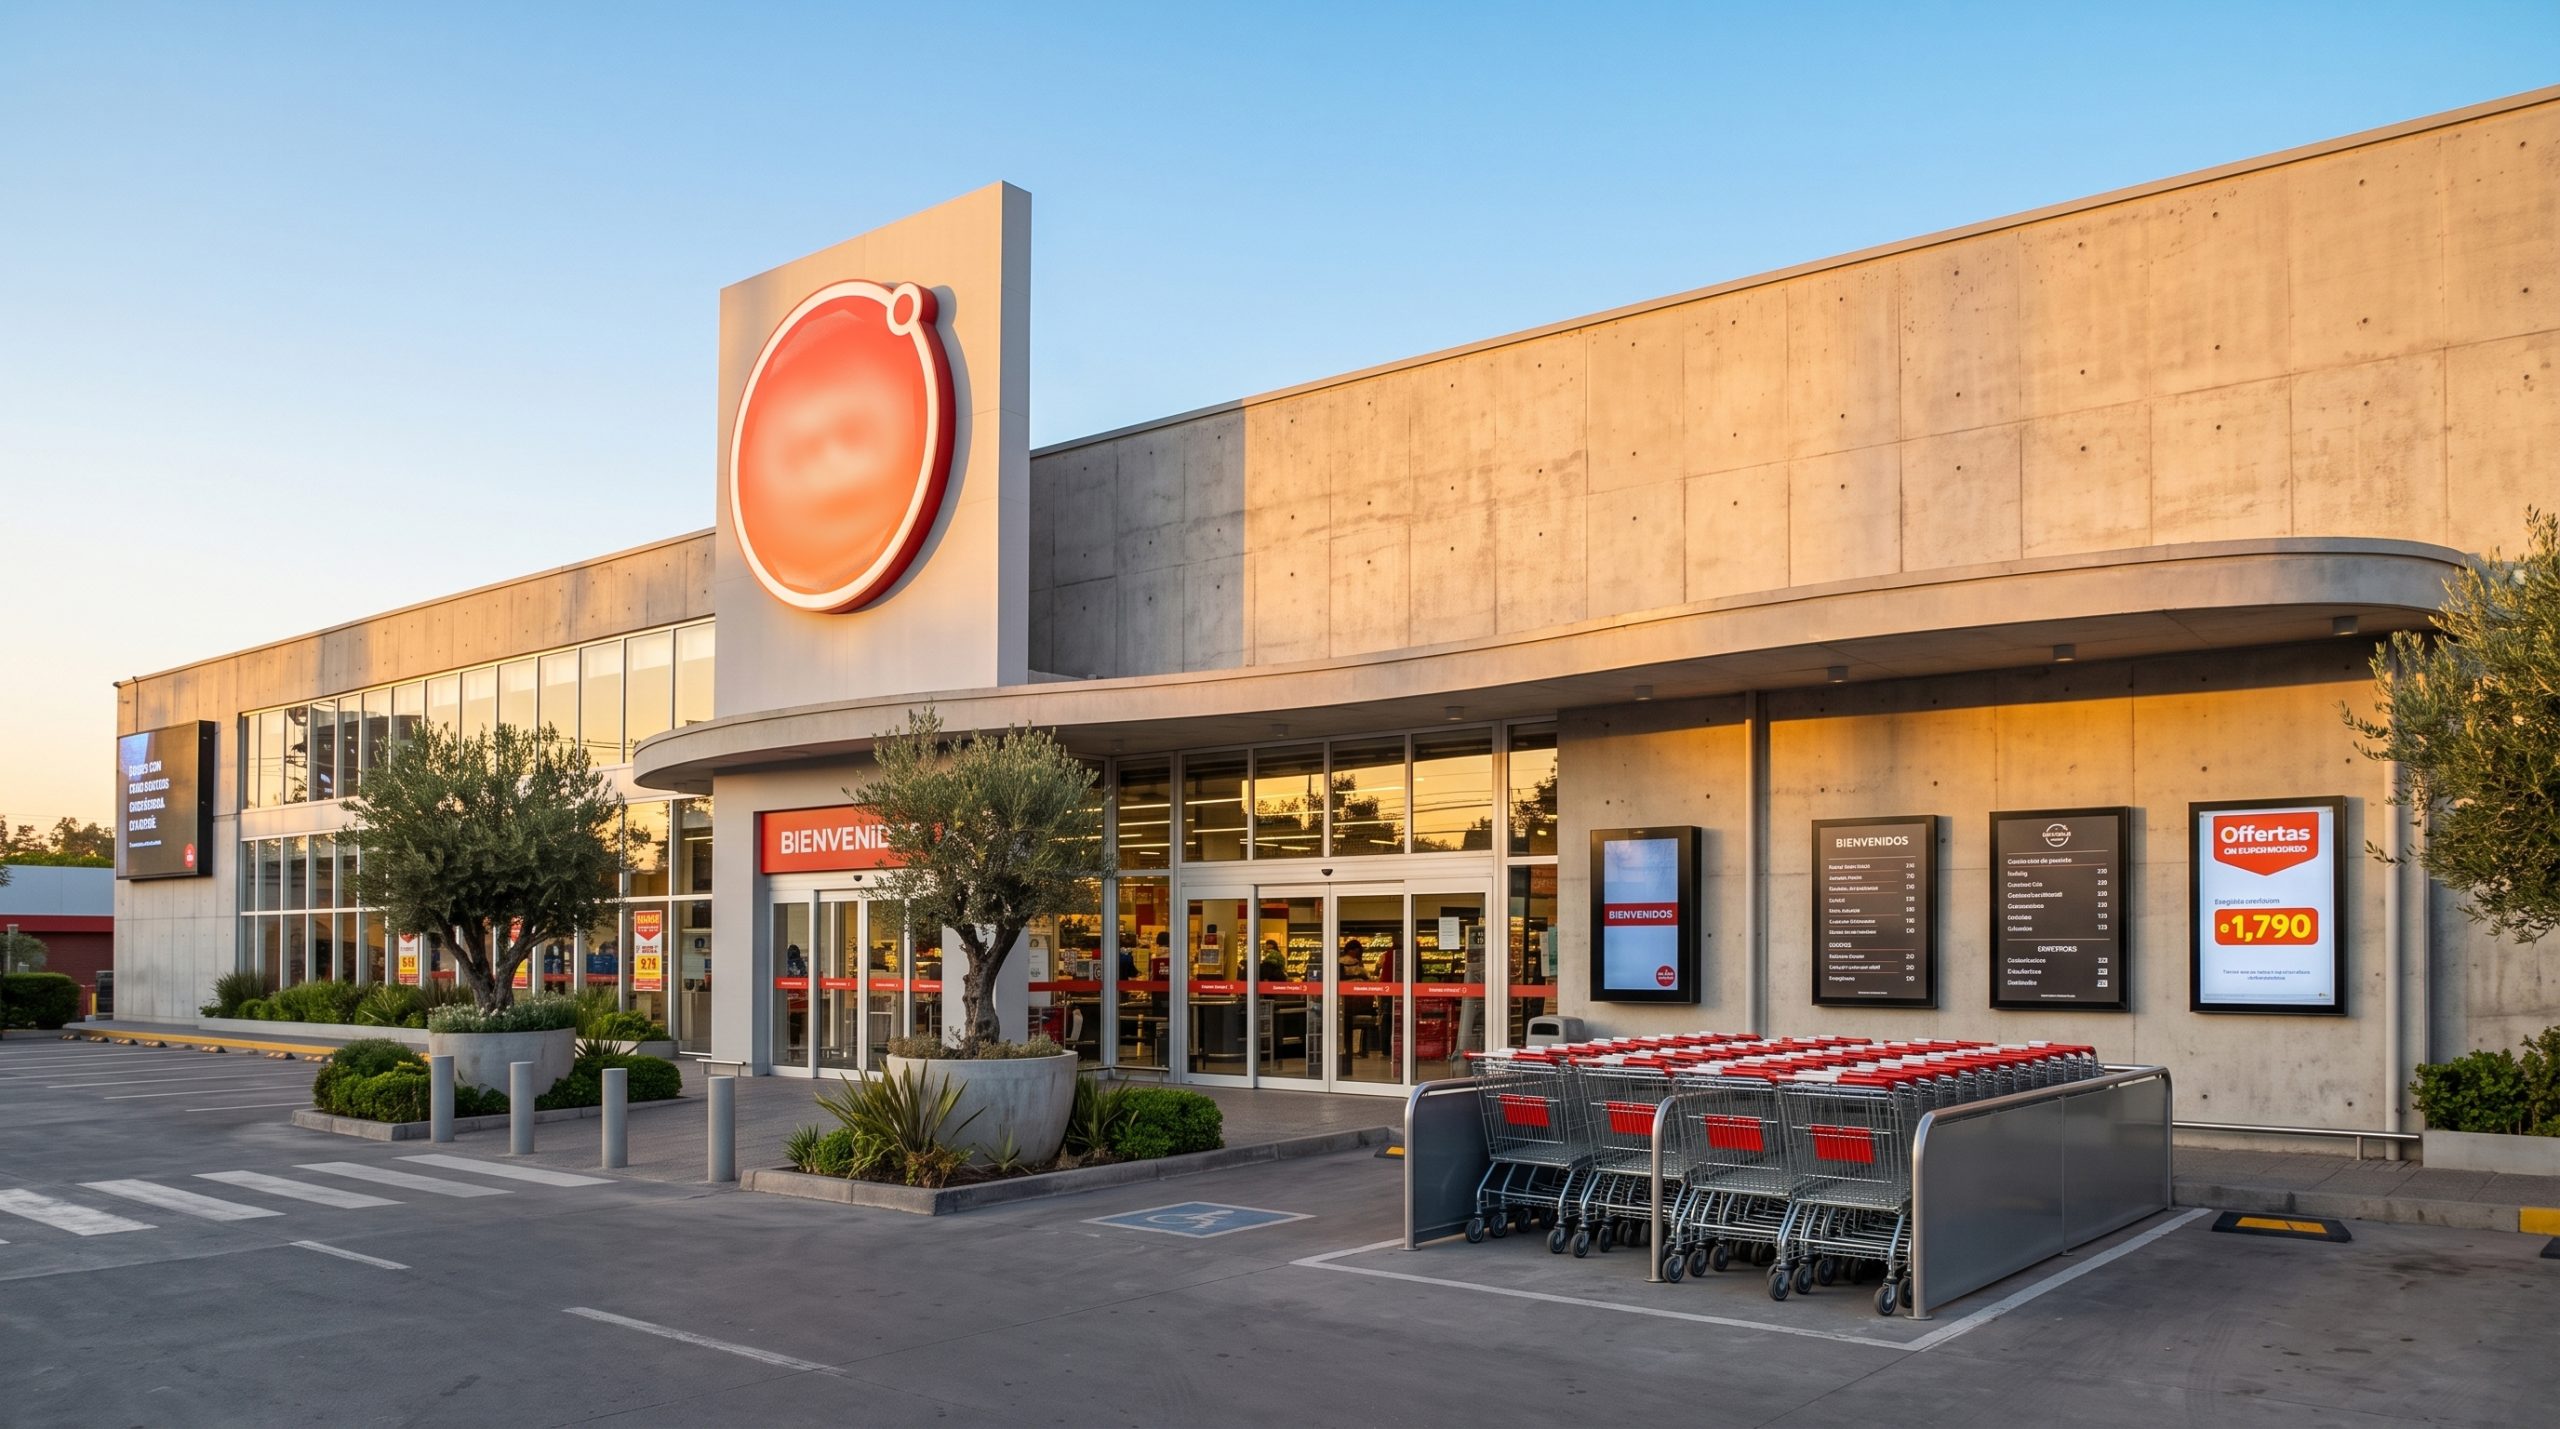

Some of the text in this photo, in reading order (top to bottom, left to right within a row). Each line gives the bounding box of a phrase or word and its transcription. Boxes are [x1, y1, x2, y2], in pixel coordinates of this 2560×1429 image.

[2220, 825, 2311, 844] Offertas
[1835, 836, 1909, 848] BIENVENIDOS
[1609, 910, 1673, 920] BIENVENIDOS
